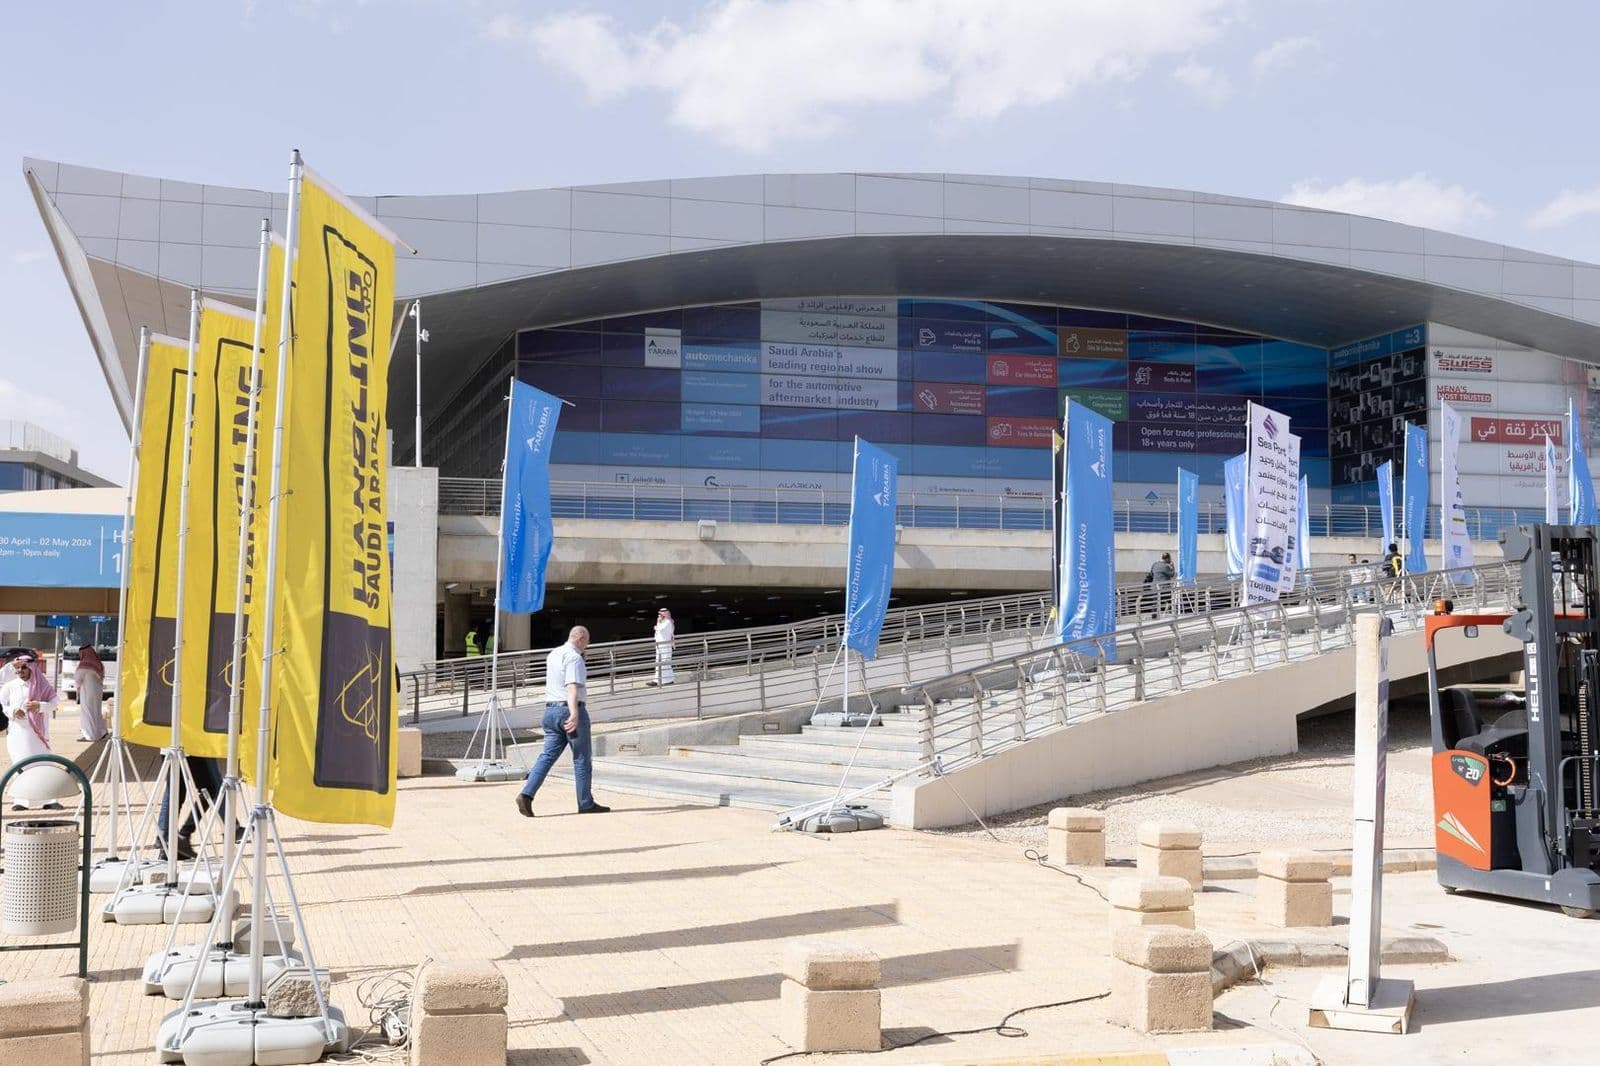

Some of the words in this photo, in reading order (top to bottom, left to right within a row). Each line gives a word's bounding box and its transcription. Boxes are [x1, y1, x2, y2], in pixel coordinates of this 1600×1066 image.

[1412, 329, 1422, 345] 3
[768, 345, 798, 357] Saudi
[800, 347, 843, 359] Arabia's
[768, 359, 807, 372] leading
[810, 363, 853, 374] regional
[855, 364, 883, 375] show
[1438, 359, 1493, 369] SWISS
[769, 378, 783, 388] for
[786, 379, 803, 390] the
[805, 381, 862, 393] automotive
[1436, 384, 1468, 393] MENA'S
[768, 392, 832, 405] aftermarket
[838, 396, 880, 408] industry
[1459, 393, 1492, 403] TRUSTED
[1187, 411, 1196, 419] 18
[1140, 427, 1161, 437] Open
[1162, 427, 1174, 436] for
[1175, 428, 1195, 437] trade
[1197, 429, 1246, 440] professionals
[1478, 421, 1497, 441] في
[1505, 421, 1526, 437] ثقة
[1528, 421, 1561, 440] الأكثر
[1141, 438, 1154, 447] 18+
[1157, 439, 1177, 449] years
[1178, 439, 1195, 450] only
[1257, 436, 1272, 451] Sea
[1273, 441, 1287, 457] Port
[1507, 449, 1537, 460] الأوسط
[1509, 461, 1535, 473] إفريقيا
[1257, 471, 1276, 482] معتمد
[0, 536, 9, 546] 30
[11, 536, 31, 549] April
[39, 537, 50, 547] 02
[52, 538, 70, 550] May
[71, 537, 93, 548] 2024
[23, 548, 42, 560] 10pm
[42, 549, 60, 561] daily
[366, 523, 382, 610] SAUDI
[1072, 523, 1088, 640] automechanika
[1529, 677, 1540, 722] HELI
[1465, 767, 1480, 781] 20
